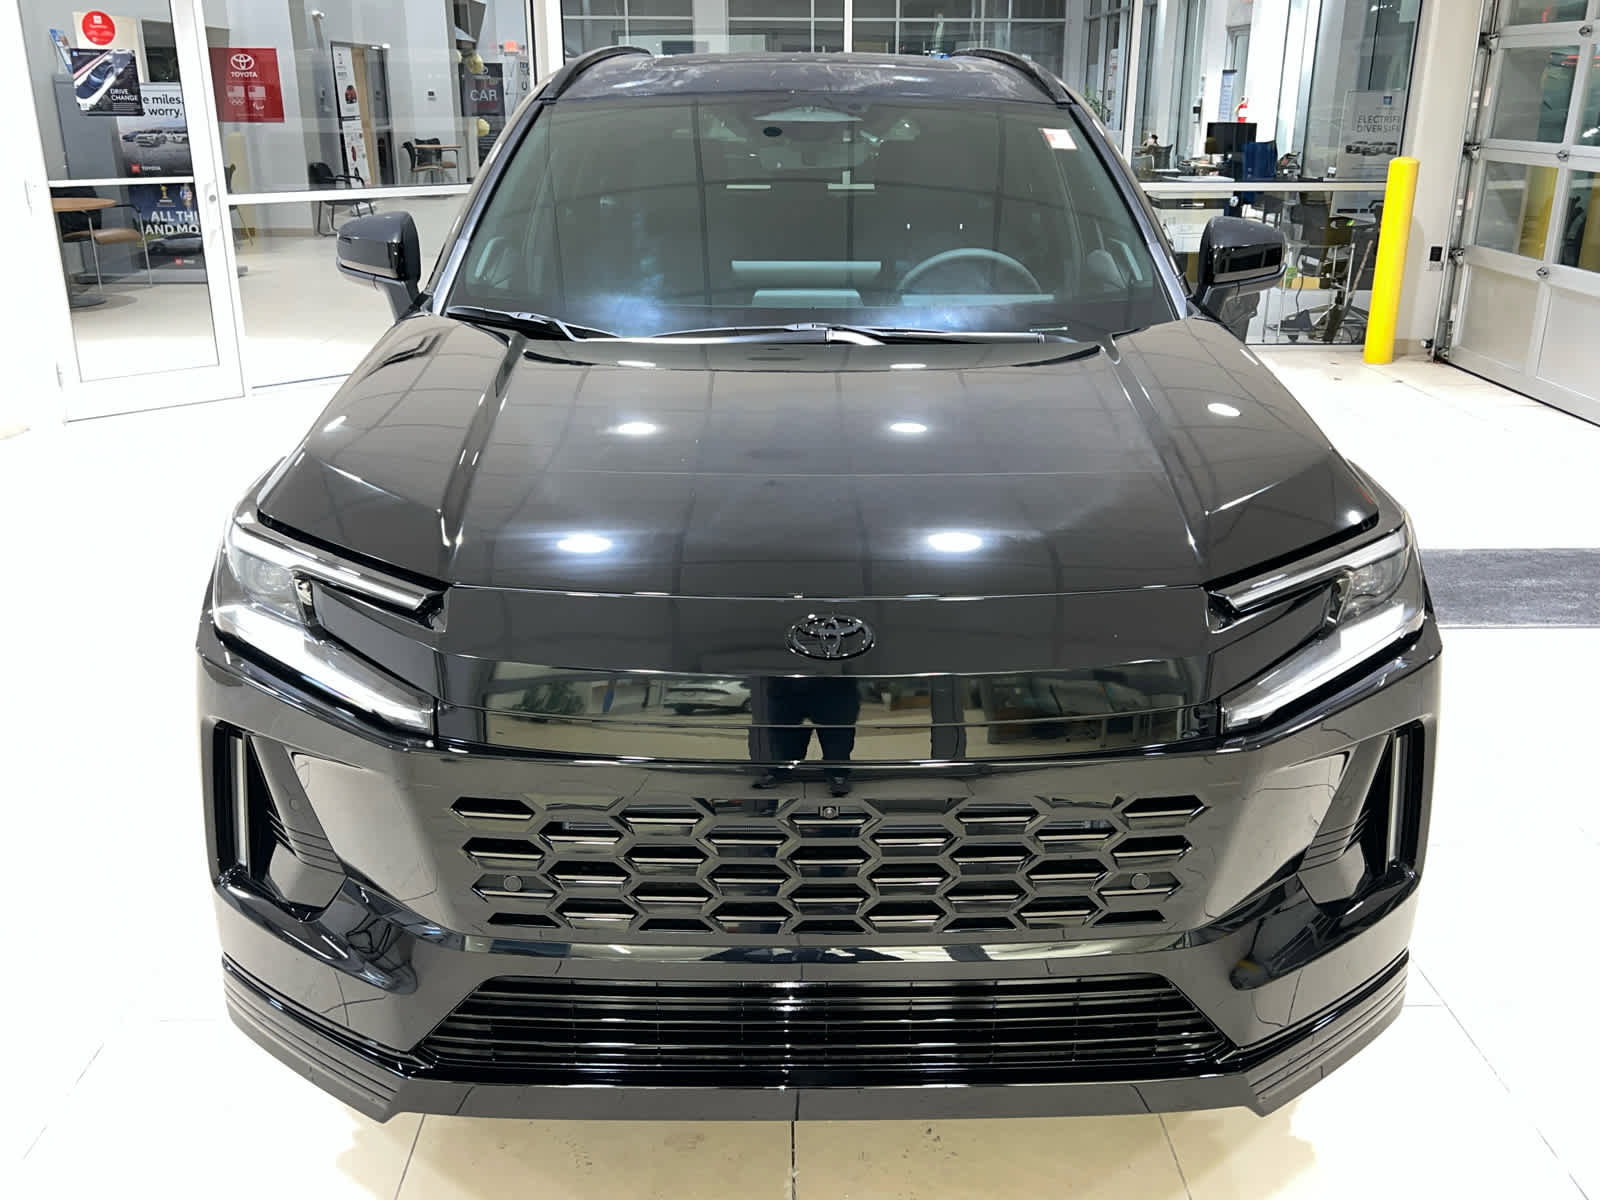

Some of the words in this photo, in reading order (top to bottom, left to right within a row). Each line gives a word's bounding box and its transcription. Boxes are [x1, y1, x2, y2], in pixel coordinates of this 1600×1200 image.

[470, 89, 497, 101] CAR
[148, 107, 183, 119] worry.
[151, 210, 175, 222] ALL
[175, 210, 199, 222] THI
[145, 223, 174, 235] AND
[176, 223, 201, 234] MO
